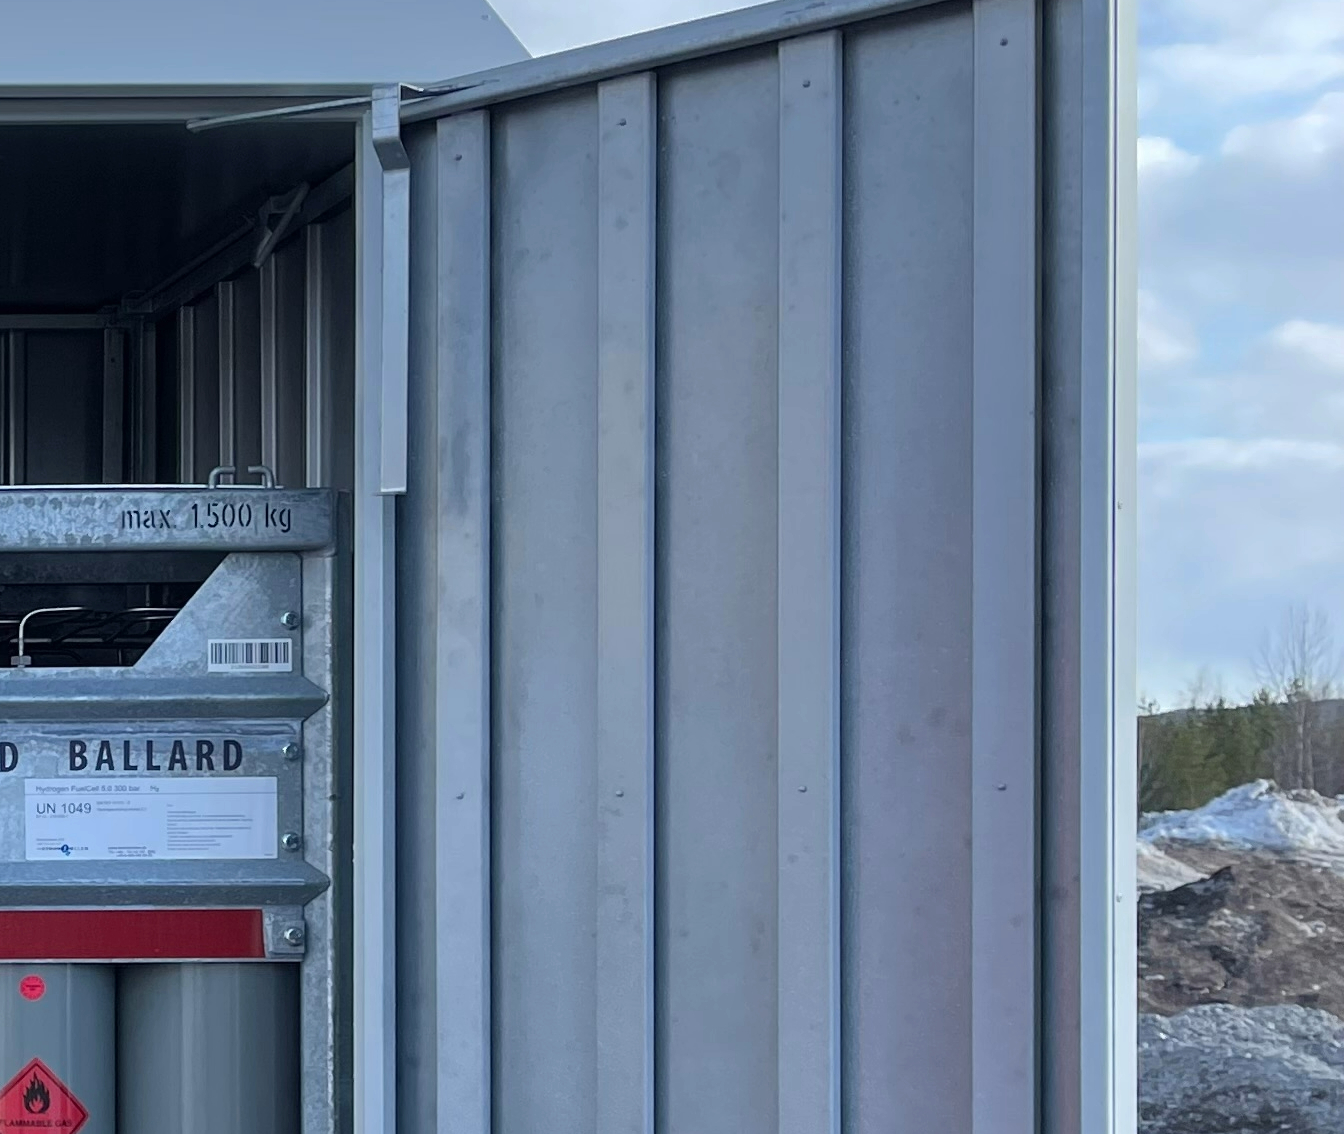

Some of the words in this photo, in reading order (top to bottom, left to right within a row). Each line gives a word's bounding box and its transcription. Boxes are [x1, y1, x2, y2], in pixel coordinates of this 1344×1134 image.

[265, 502, 291, 533] kg
[69, 739, 243, 772] BALLARD
[35, 785, 69, 793] Hydrogen
[36, 802, 56, 815] UN
[61, 802, 92, 814] 1049
[0, 1119, 52, 1127] FLAMMABLE
[54, 1119, 72, 1127] GAS
